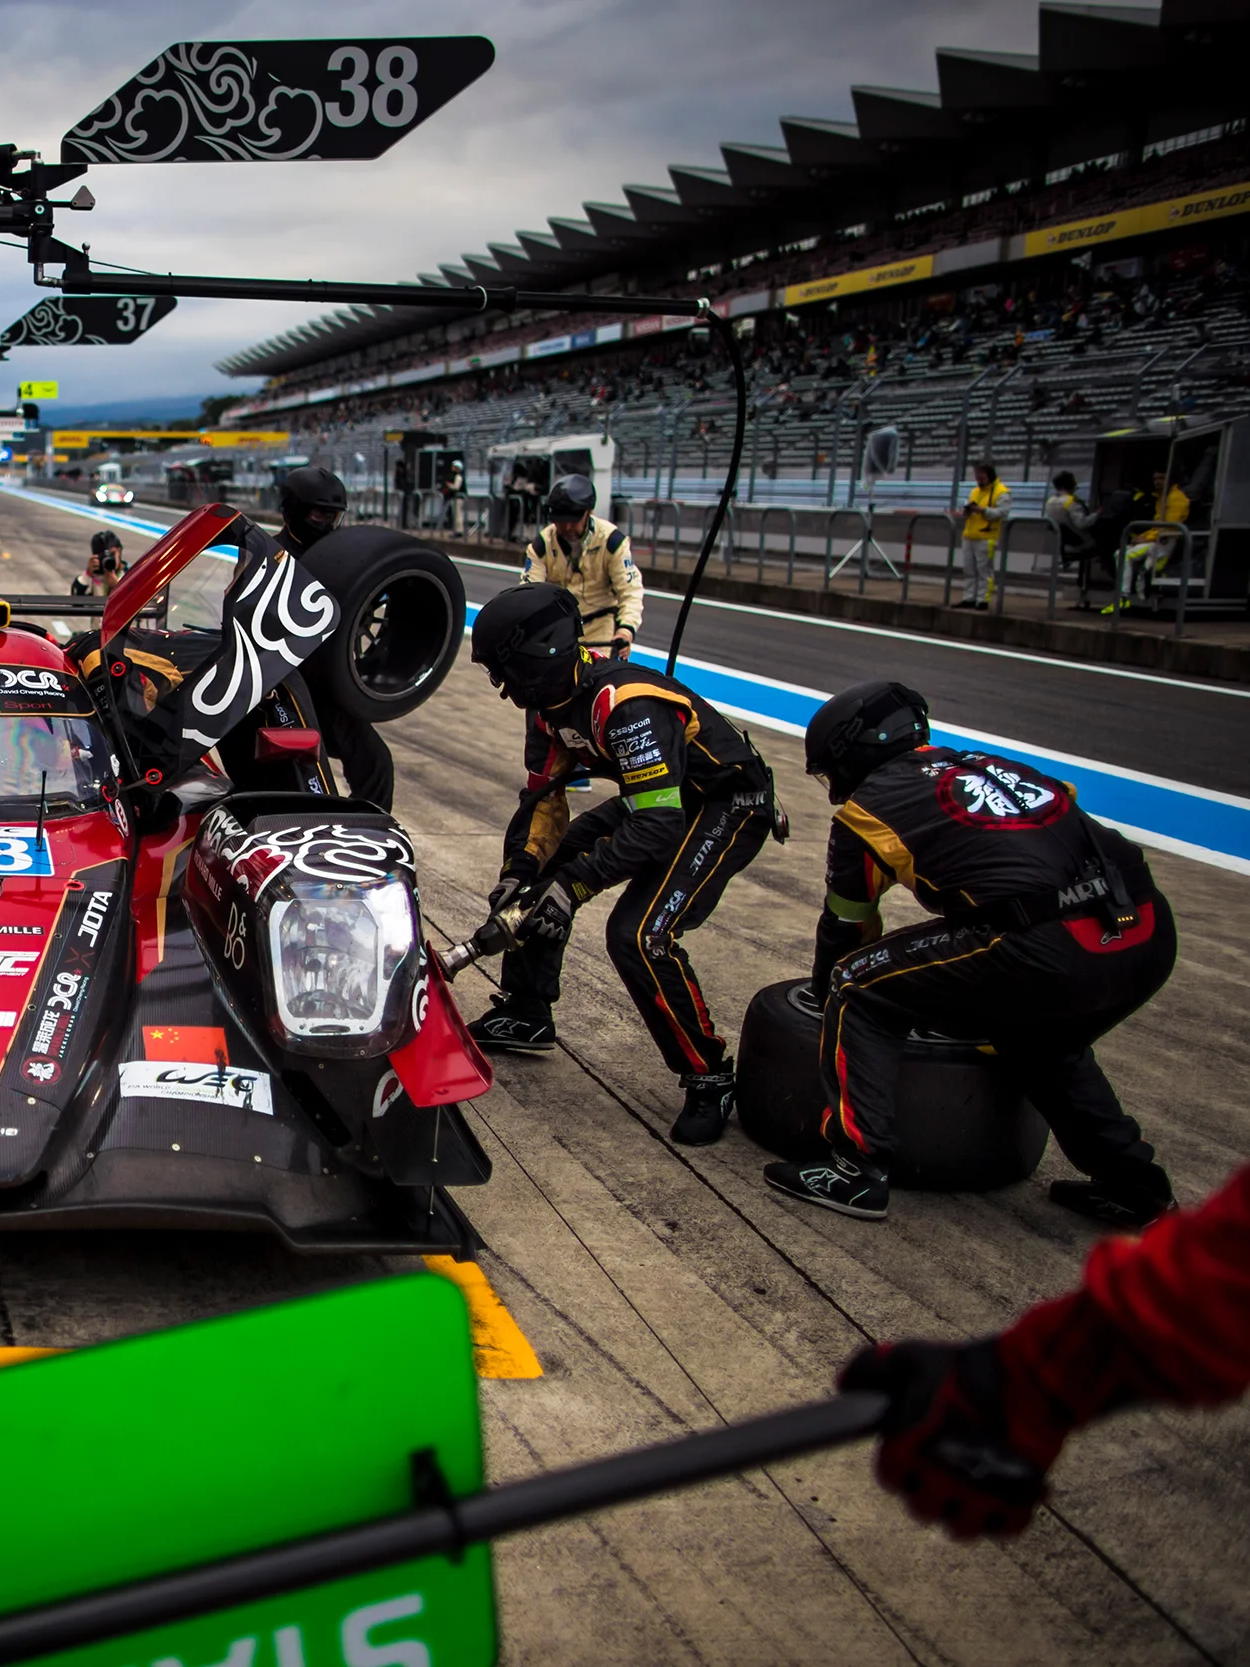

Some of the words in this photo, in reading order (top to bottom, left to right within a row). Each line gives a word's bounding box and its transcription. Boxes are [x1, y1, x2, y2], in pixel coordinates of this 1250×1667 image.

[325, 45, 418, 128] 38
[1057, 221, 1117, 245] DUNLOP
[875, 265, 916, 283] DUNLOP
[116, 298, 156, 331] 37
[5, 701, 53, 710] Sport
[43, 690, 66, 698] Racing
[630, 767, 665, 781] DUNLOP
[689, 839, 714, 877] JOTA
[711, 812, 729, 837] Sport
[77, 891, 113, 948] JOTA
[906, 933, 950, 953] JOTA
[156, 1069, 258, 1092] WEC
